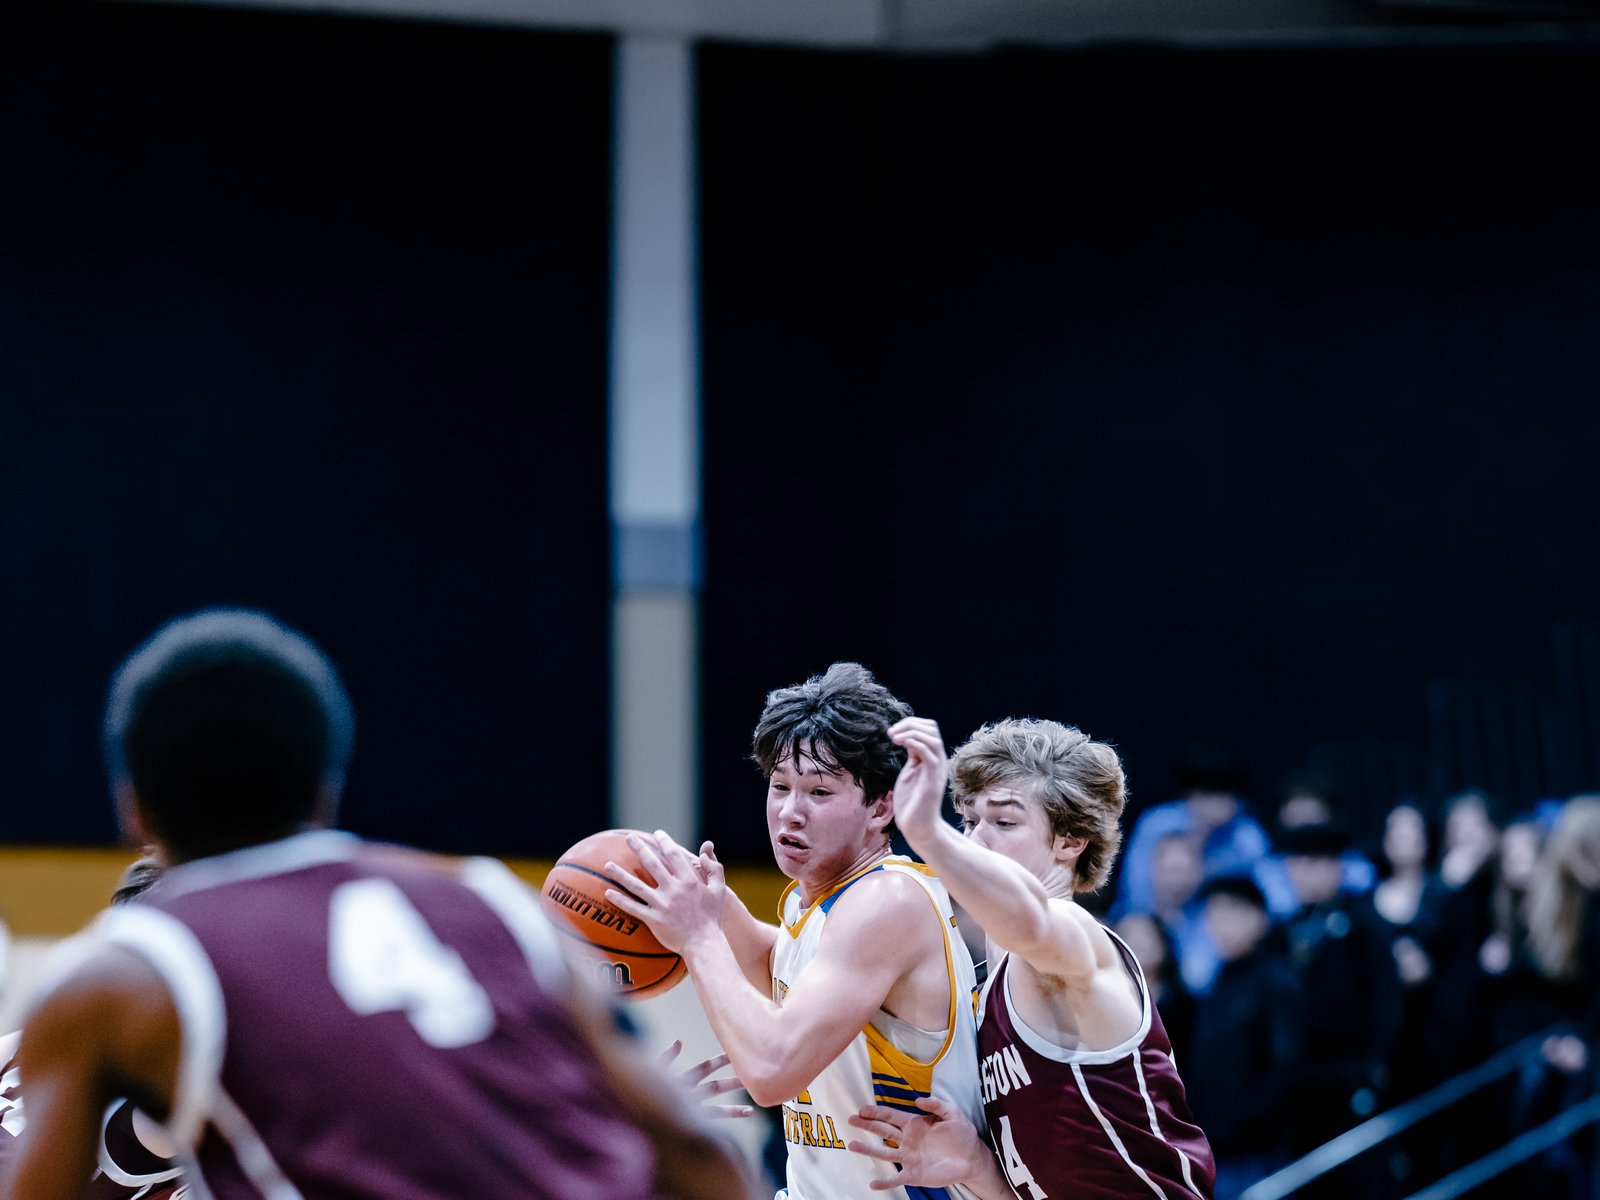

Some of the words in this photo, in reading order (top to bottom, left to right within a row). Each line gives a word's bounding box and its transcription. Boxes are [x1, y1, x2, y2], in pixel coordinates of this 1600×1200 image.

[548, 883, 640, 936] EVOLUTION
[329, 879, 495, 1048] 4
[782, 1104, 846, 1150] NTRAL
